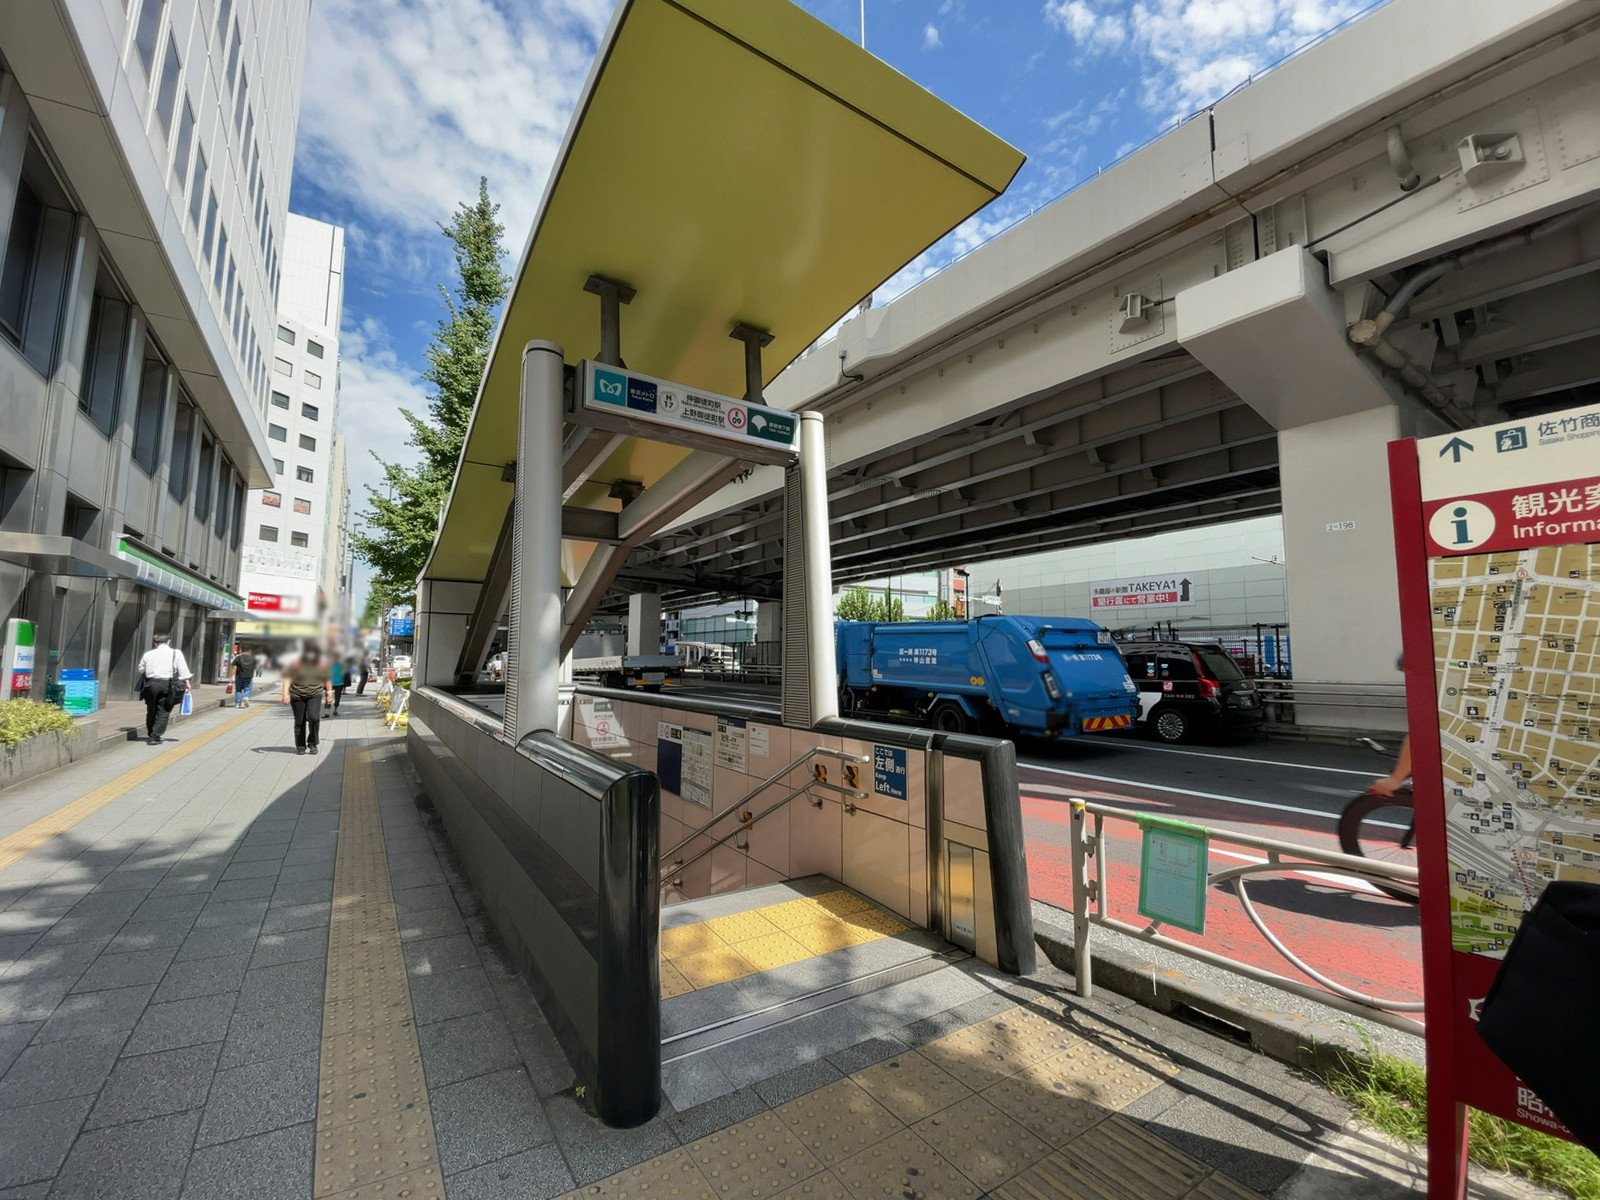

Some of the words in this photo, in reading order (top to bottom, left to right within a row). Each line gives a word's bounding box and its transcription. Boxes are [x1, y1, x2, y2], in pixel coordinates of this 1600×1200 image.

[664, 400, 674, 408] 17
[1513, 519, 1600, 538] Inform
[1128, 579, 1176, 593] TAKEYA1
[875, 756, 895, 773] 左側
[876, 781, 890, 793] Left
